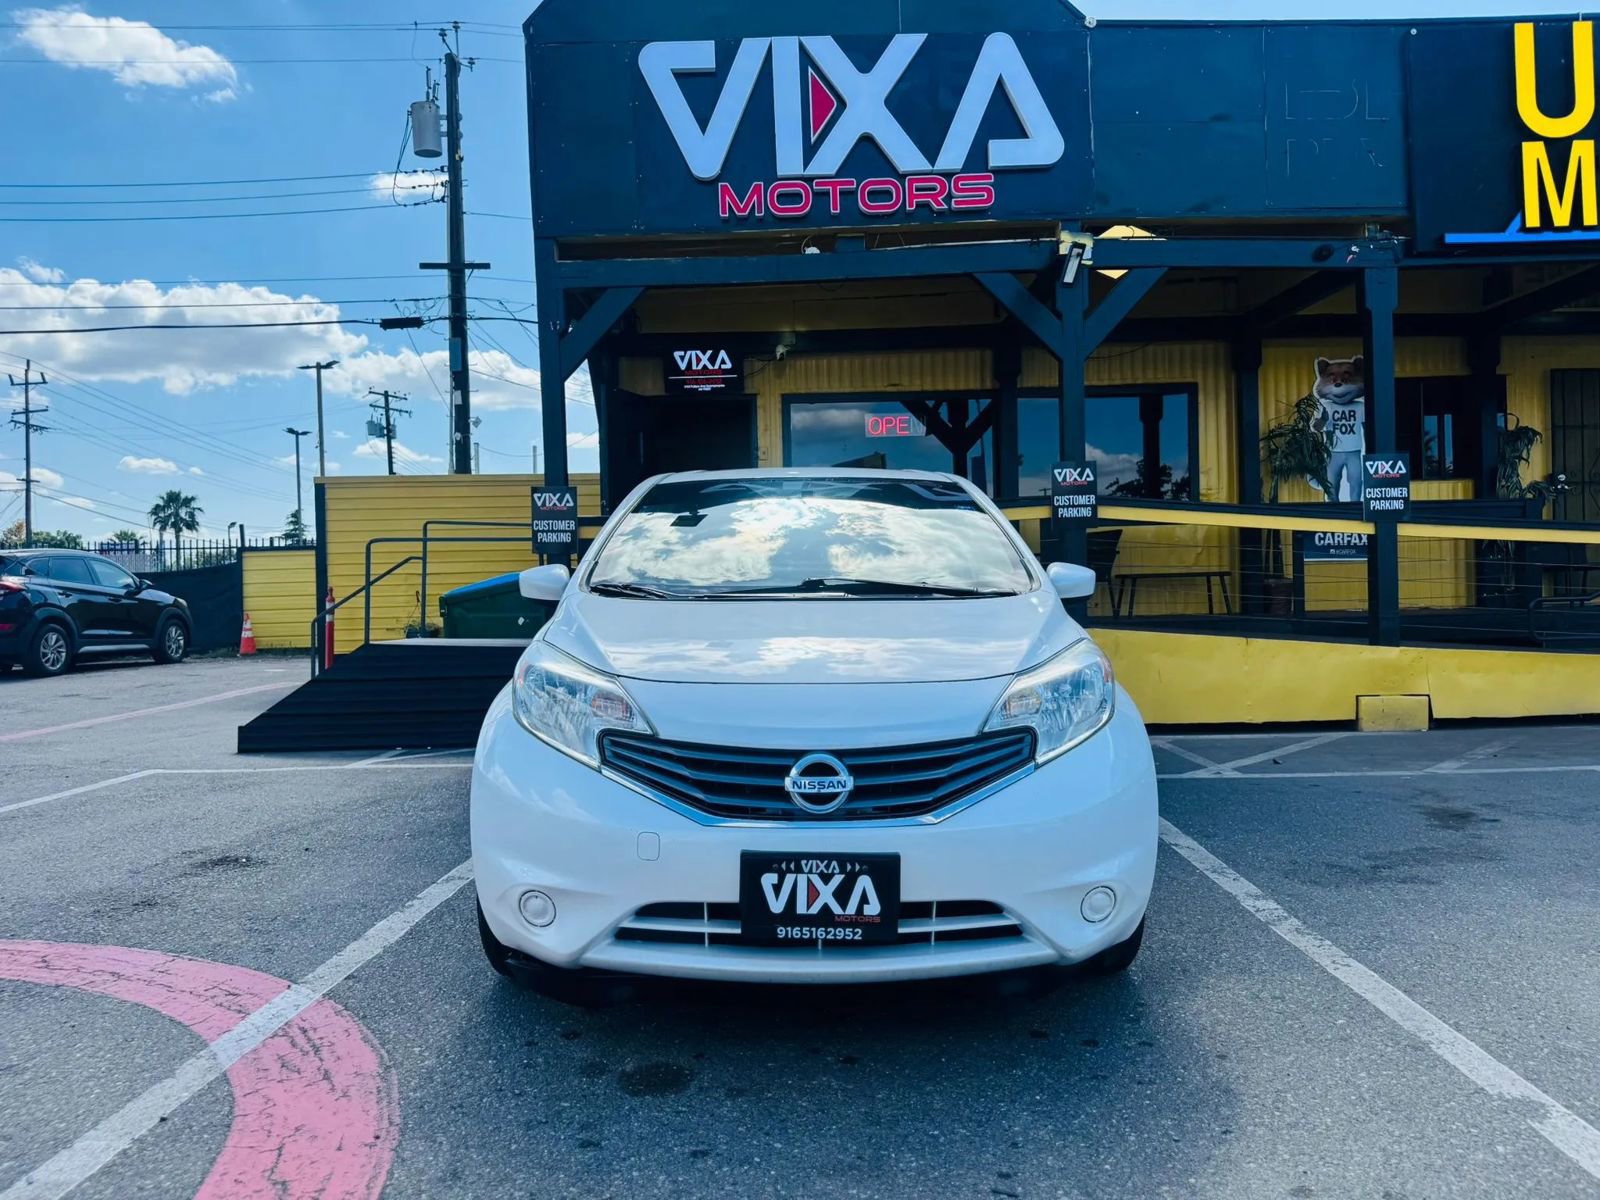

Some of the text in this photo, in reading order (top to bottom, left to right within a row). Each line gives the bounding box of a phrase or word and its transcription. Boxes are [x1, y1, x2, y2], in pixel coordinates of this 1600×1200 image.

[638, 32, 1065, 181] VIXA
[718, 172, 996, 218] MOTORS
[673, 349, 732, 370] VIXA
[1331, 409, 1357, 422] CAR
[1332, 423, 1356, 435] FOX
[1365, 460, 1407, 474] VIXA
[1053, 467, 1095, 482] VIXA
[1365, 487, 1408, 498] CUSTOMER
[533, 493, 575, 507] VIXA
[1053, 494, 1096, 506] CUSTOMER
[1370, 500, 1404, 511] PARKING
[1058, 507, 1092, 518] PARKING
[533, 520, 576, 531] CUSTOMER
[537, 532, 572, 543] PARKING
[1314, 532, 1369, 546] CARFAX
[792, 780, 847, 790] NISSAN
[801, 860, 840, 873] VIXA
[760, 873, 881, 916] VIXA
[834, 915, 881, 923] MOTORS
[777, 927, 863, 940] 9165162952
